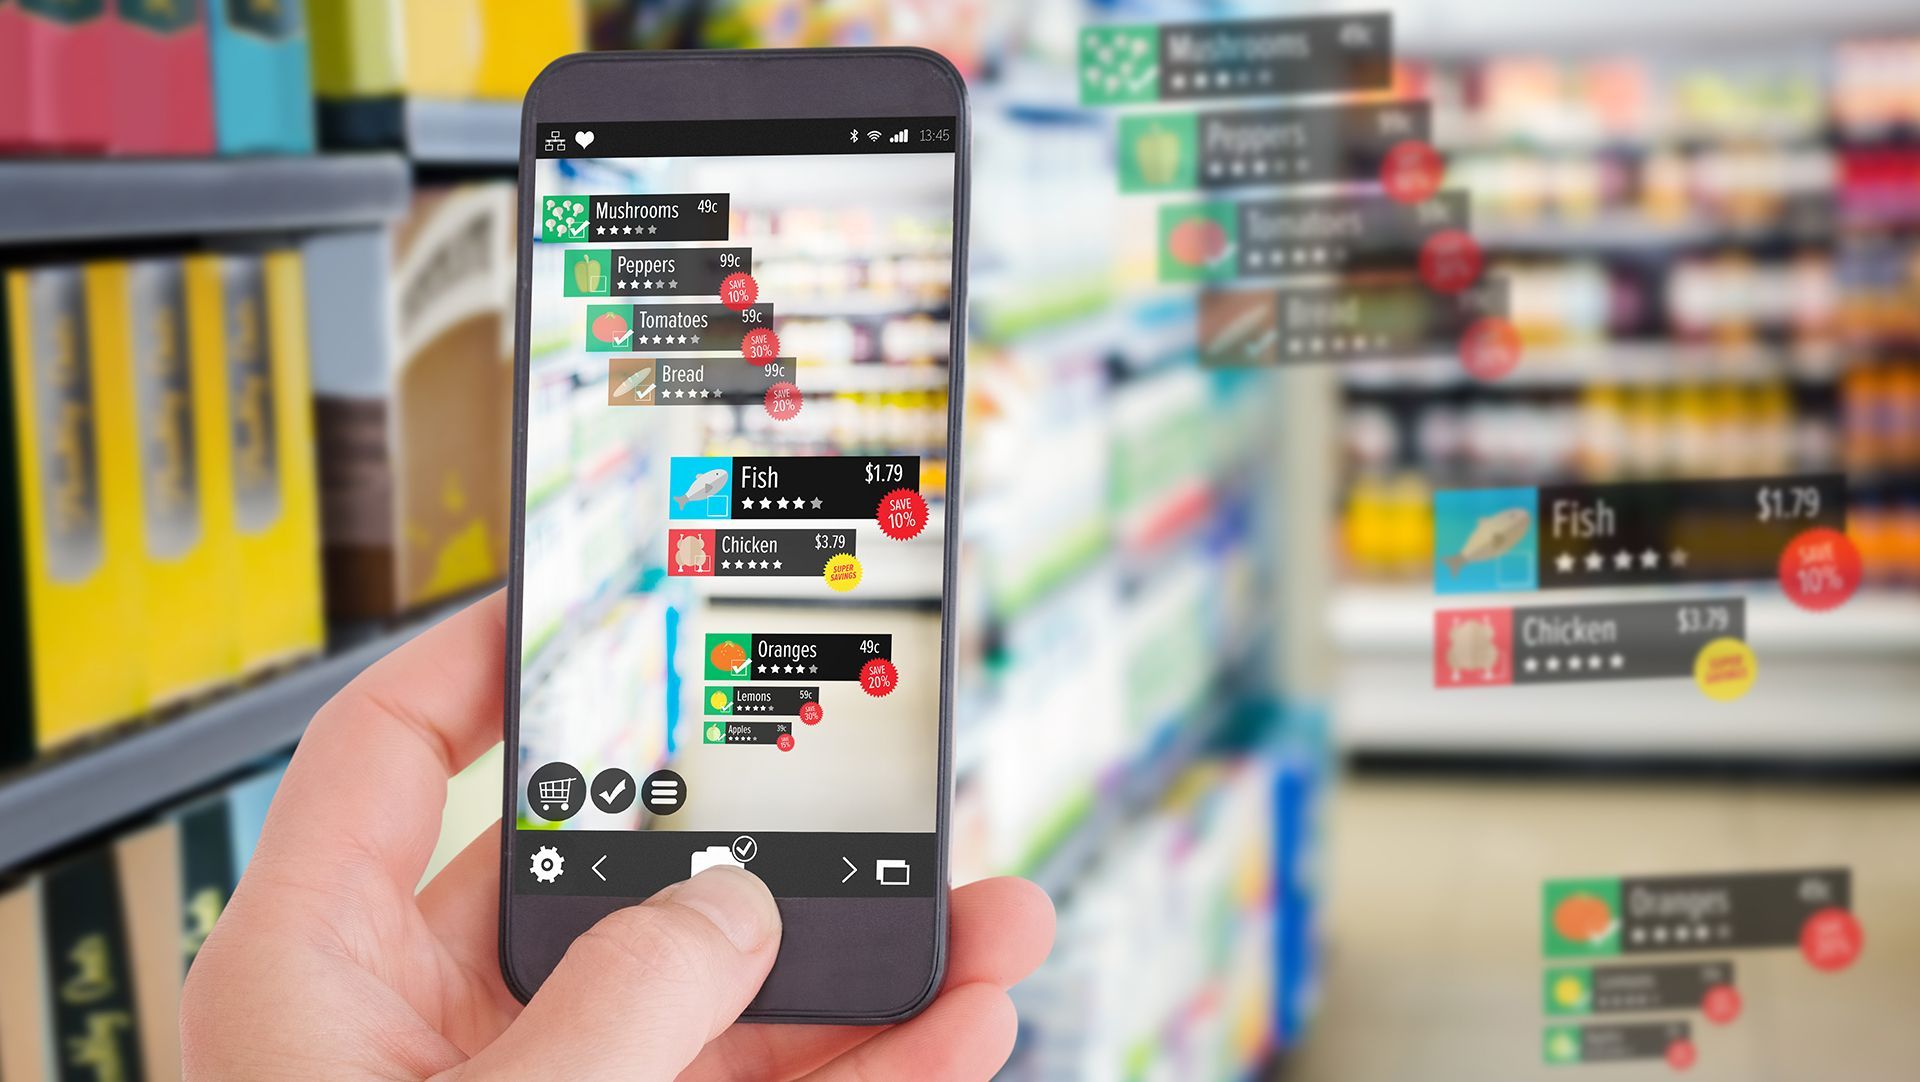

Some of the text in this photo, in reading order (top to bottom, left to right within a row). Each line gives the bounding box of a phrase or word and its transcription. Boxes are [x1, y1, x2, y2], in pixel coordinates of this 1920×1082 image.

[919, 128, 950, 142] 13:45
[595, 200, 679, 220] Mushrooms
[697, 199, 718, 215] 49c
[617, 255, 676, 277] Peppers
[719, 253, 741, 268] 99c
[728, 279, 746, 291] SAVE
[728, 289, 749, 303] 10%
[639, 310, 709, 330] Tomatoes
[741, 308, 763, 324] 59c
[750, 334, 768, 345] SAVE
[749, 344, 773, 359] 30%
[662, 364, 704, 383] Bread
[764, 363, 785, 378] 99c
[773, 388, 791, 400] SAVE
[772, 398, 796, 413] 20%
[740, 464, 779, 490] Fish
[864, 462, 903, 485] $1.79
[889, 497, 912, 512] SAVE
[887, 511, 916, 530] 10%
[721, 536, 778, 554] Chicken
[814, 533, 846, 551] $3.79
[833, 563, 854, 574] SUPER
[829, 571, 857, 582] SAVINGS
[757, 640, 817, 662] Oranges
[859, 639, 880, 654] 49c
[869, 665, 886, 676] SAVE
[868, 675, 891, 689] 20%
[737, 690, 771, 702] Lemons
[799, 689, 812, 700] 59c
[804, 712, 818, 721] 30%
[728, 724, 752, 735] Apples
[776, 724, 787, 732] 39c
